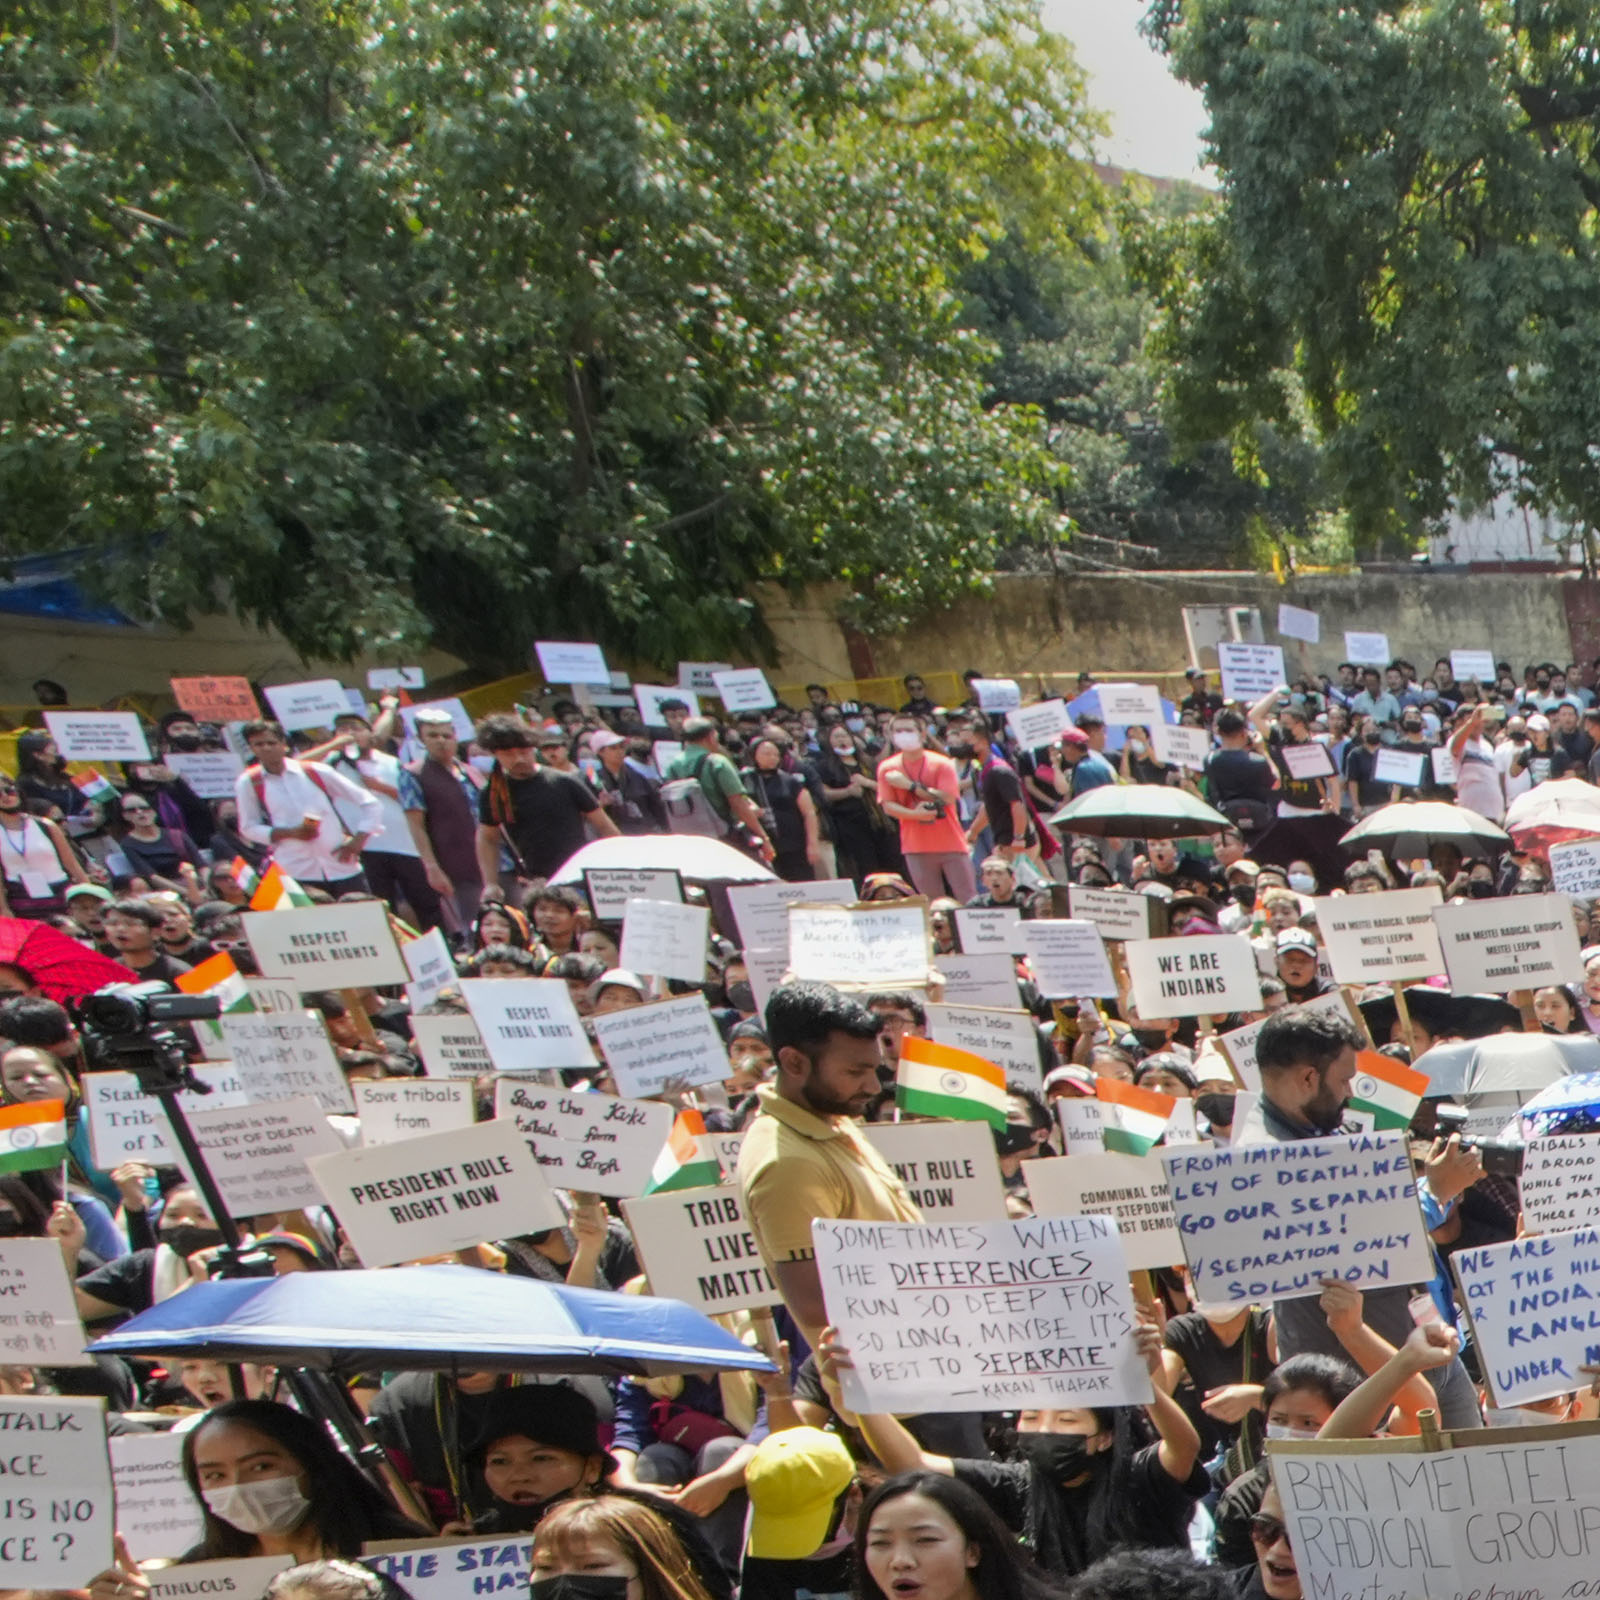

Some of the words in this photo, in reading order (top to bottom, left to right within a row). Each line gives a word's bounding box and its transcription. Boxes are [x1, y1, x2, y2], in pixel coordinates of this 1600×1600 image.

[291, 931, 348, 946] RESPECT
[1455, 932, 1471, 942] BAN
[1473, 928, 1498, 941] MEITEI
[1502, 925, 1532, 939] RADICAL
[1534, 921, 1563, 935] GROUPS
[279, 950, 326, 965] TRIBAL
[332, 946, 378, 960] RIGHTS
[1486, 944, 1511, 955] MEITEI
[1513, 941, 1541, 953] LEEPUN
[1158, 956, 1184, 973] WE
[1189, 953, 1220, 971] ARE
[1485, 966, 1520, 978] ARAMBAI
[1523, 961, 1554, 974] TENGGOL
[1160, 976, 1226, 998] INDIANS
[505, 1007, 549, 1021] RESPECT
[498, 1026, 537, 1039] TRIBAL
[541, 1025, 574, 1039] RIGHTS
[351, 1167, 459, 1205] PRESIDENT
[463, 1156, 513, 1180] RULE
[389, 1199, 447, 1224] RIGHT
[456, 1185, 500, 1210] NOW
